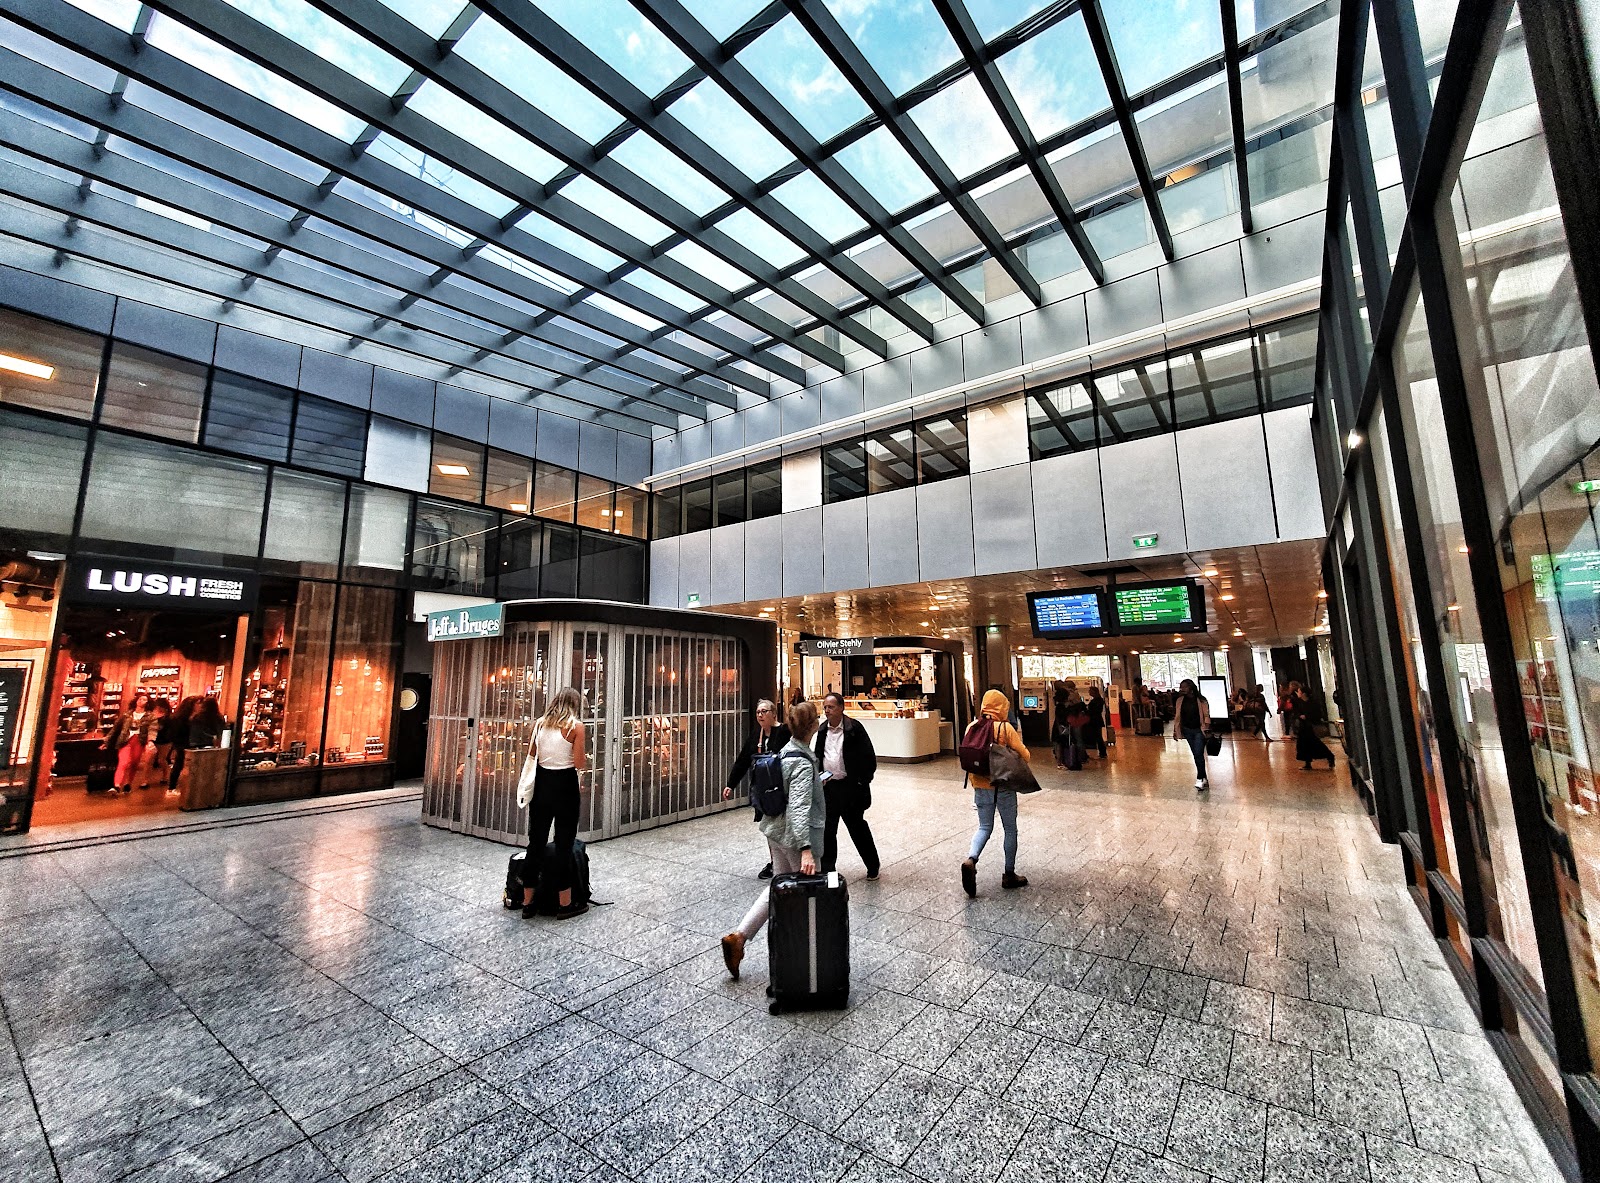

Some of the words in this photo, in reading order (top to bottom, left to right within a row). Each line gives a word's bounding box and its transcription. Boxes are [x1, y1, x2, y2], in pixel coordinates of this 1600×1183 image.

[88, 568, 197, 597] LUSH
[201, 579, 243, 590] FRESH
[200, 587, 242, 595] HANDMADE
[200, 592, 242, 600] COSMETICS
[430, 616, 449, 638] Jeff
[449, 622, 459, 635] de
[459, 611, 500, 636] Bruges
[840, 639, 862, 648] Stehly
